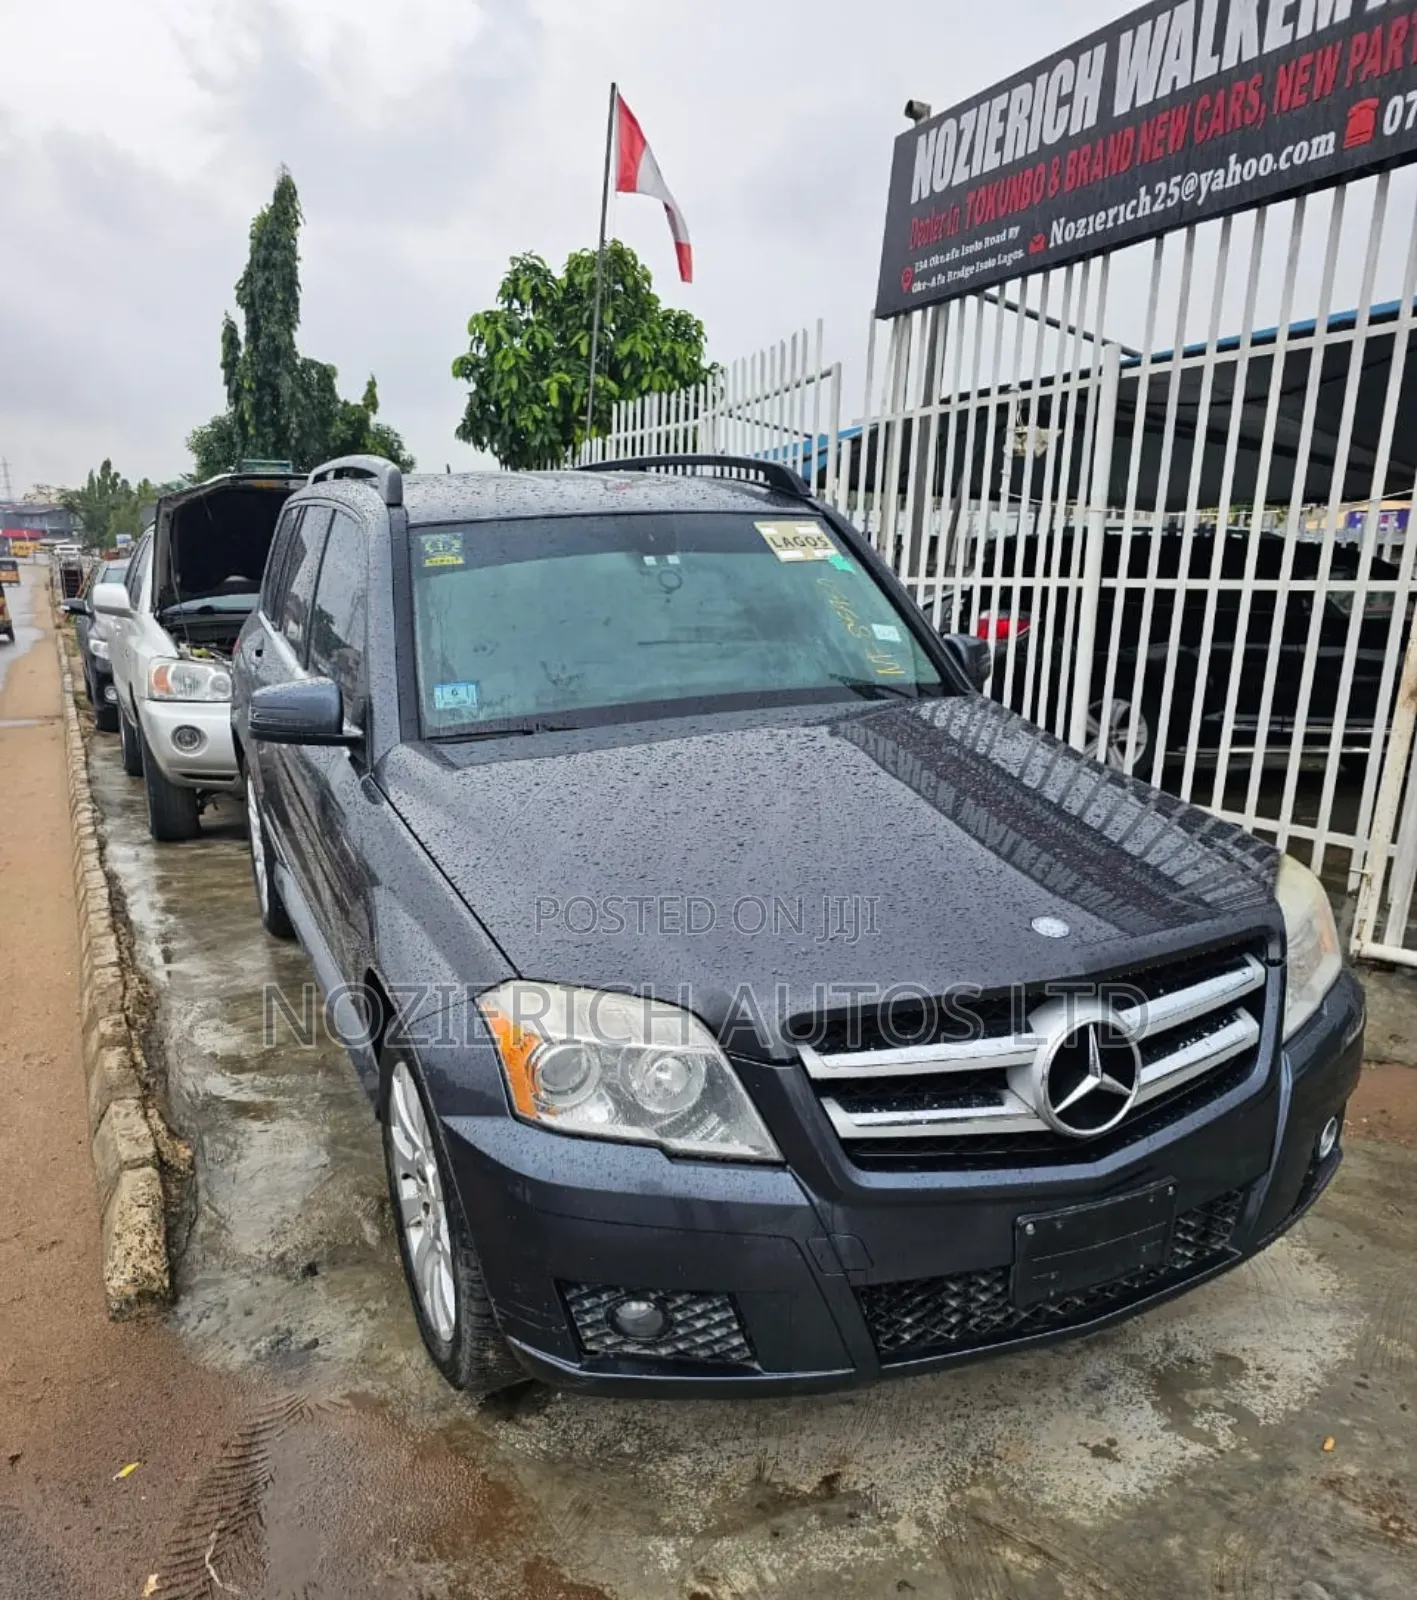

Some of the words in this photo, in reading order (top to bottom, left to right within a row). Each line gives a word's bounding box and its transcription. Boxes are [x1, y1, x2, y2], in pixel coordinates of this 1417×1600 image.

[910, 42, 1108, 205] NOZIERICH
[965, 162, 1046, 231] TOKUNBO
[1048, 156, 1061, 198] &
[1064, 126, 1136, 193] BRAND
[1136, 103, 1191, 166] NEW
[1193, 73, 1267, 144] CARS,
[1272, 40, 1343, 115] NEW
[984, 229, 1007, 248] Road
[1049, 130, 1336, 248] Nozierich25@yahoo.com
[769, 535, 830, 549] LAGOS
